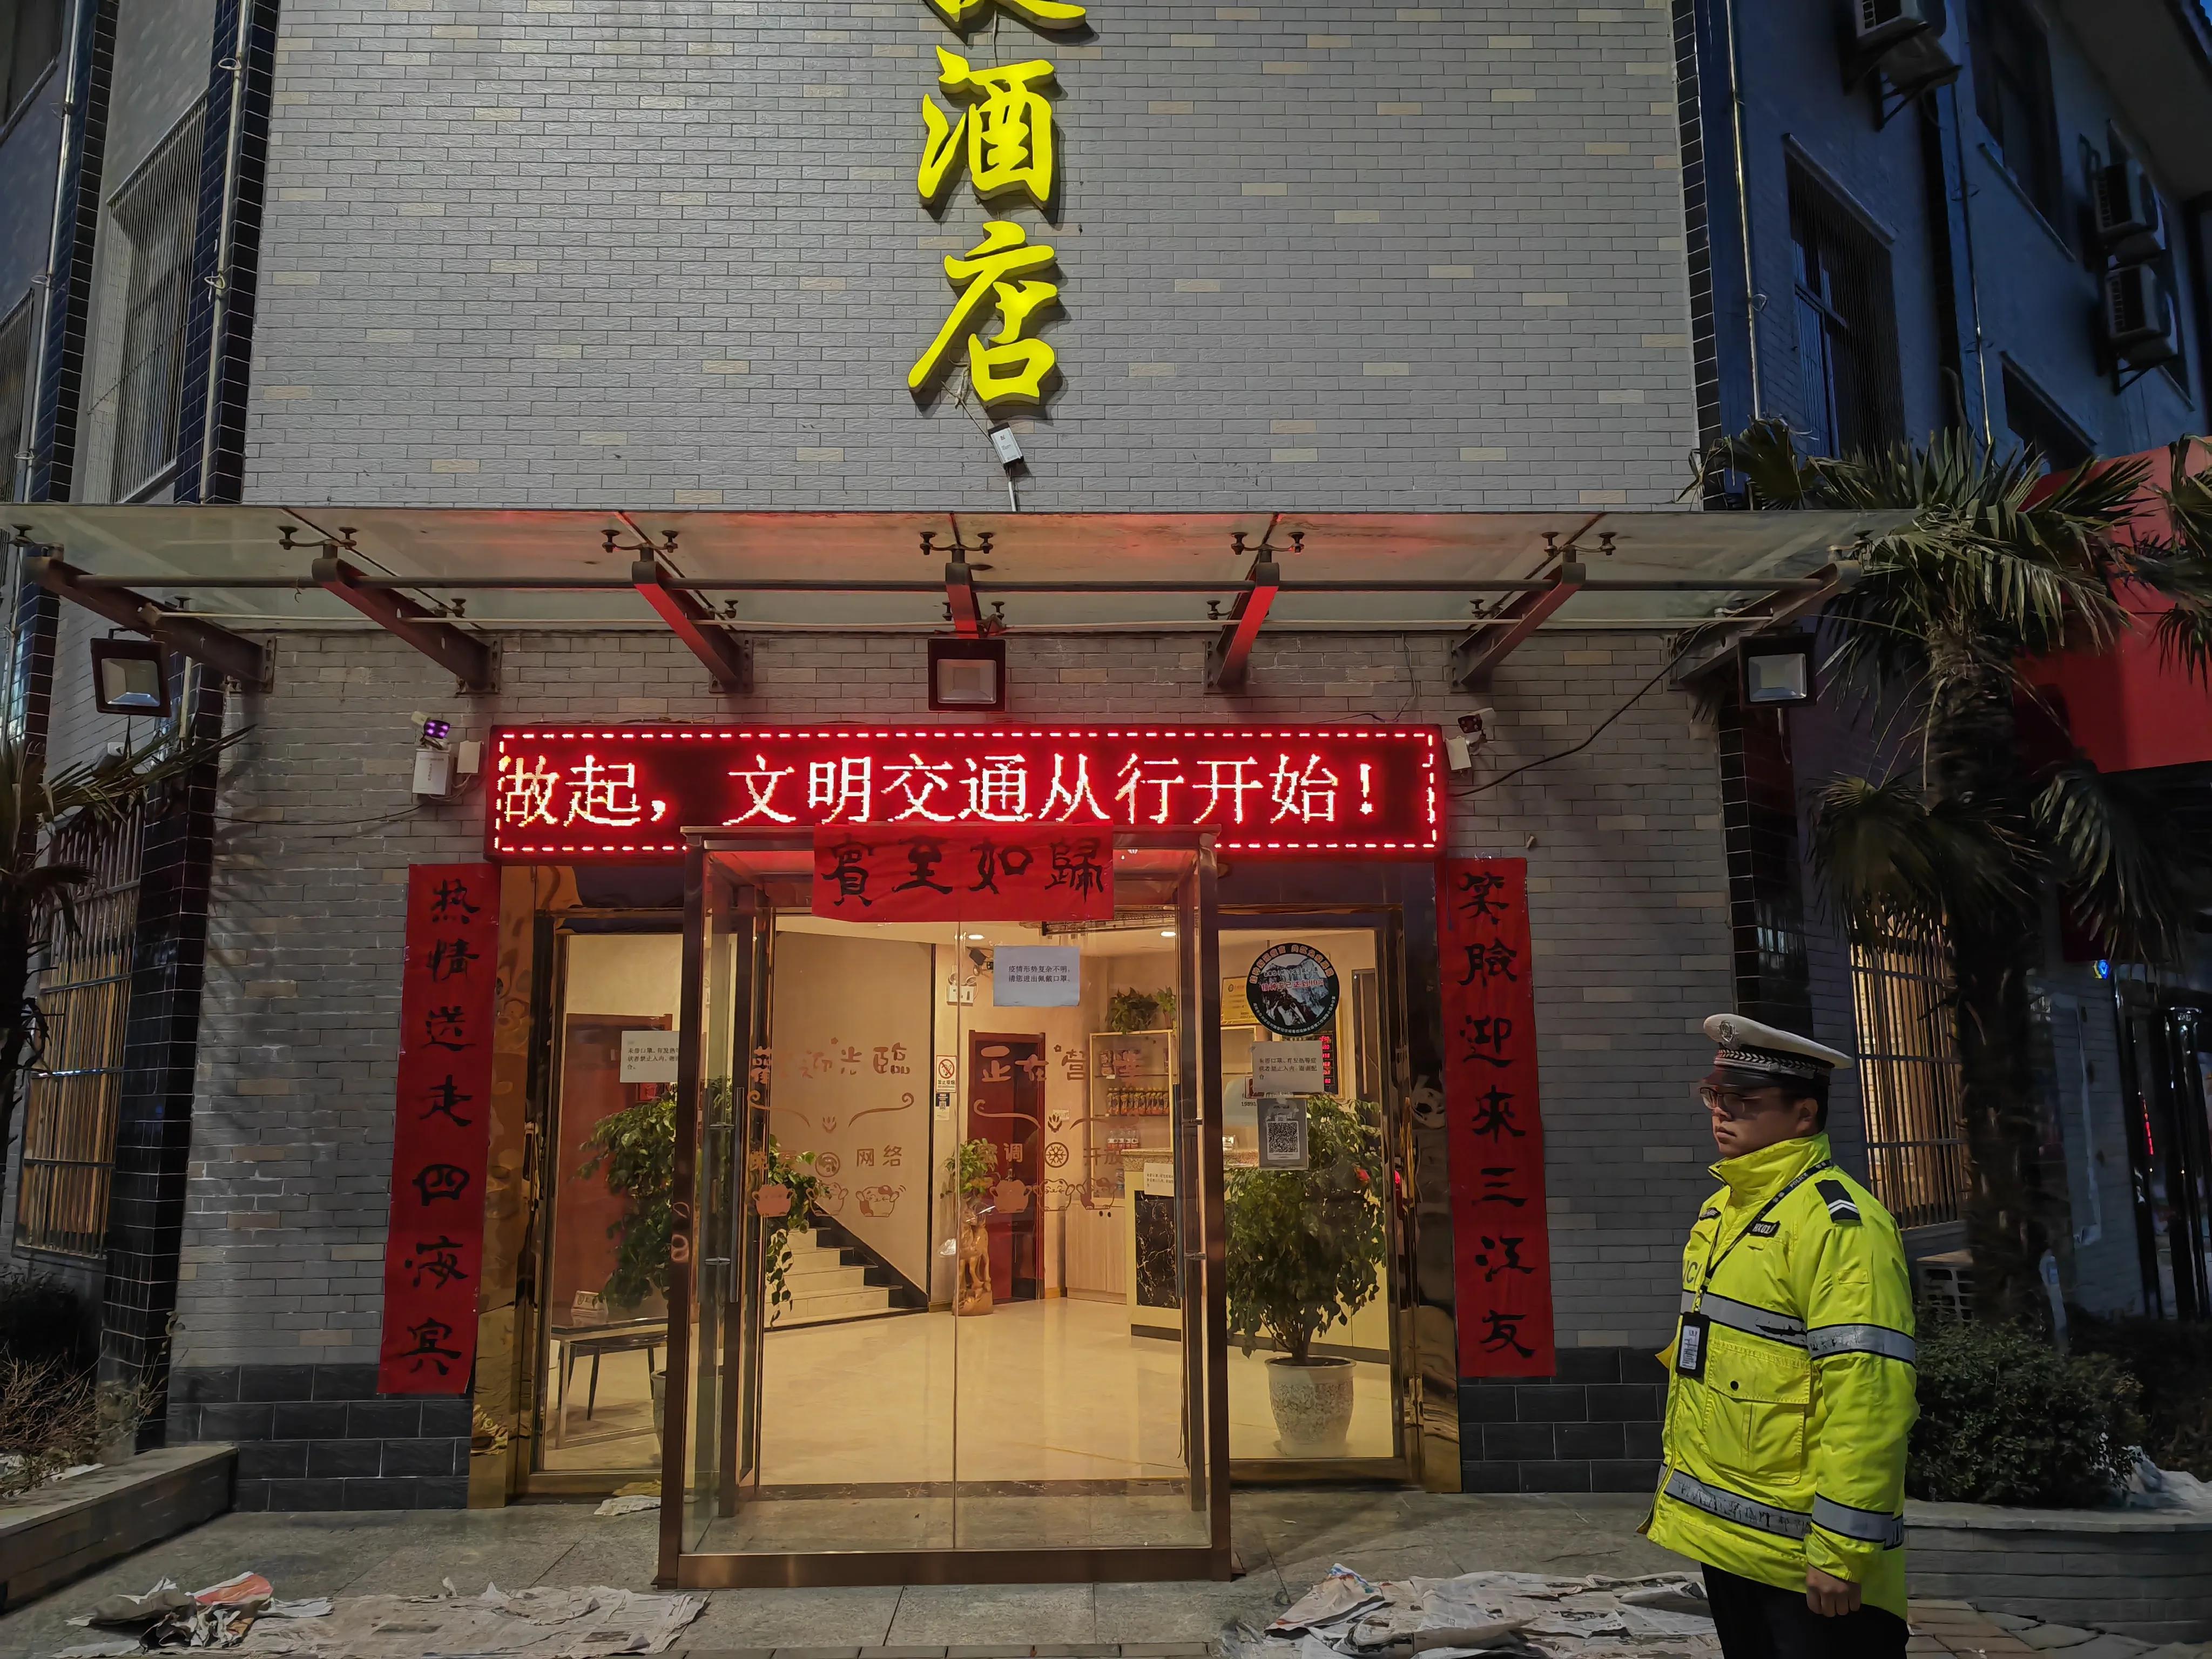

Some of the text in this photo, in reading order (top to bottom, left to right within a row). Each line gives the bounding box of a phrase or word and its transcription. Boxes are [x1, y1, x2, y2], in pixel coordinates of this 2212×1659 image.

[721, 753, 1374, 826] 文明交通从行开始！
[821, 833, 1104, 903] 賓至如歸
[404, 878, 481, 1375] 热情送走四海宾
[1790, 1172, 1809, 1189] POLICE
